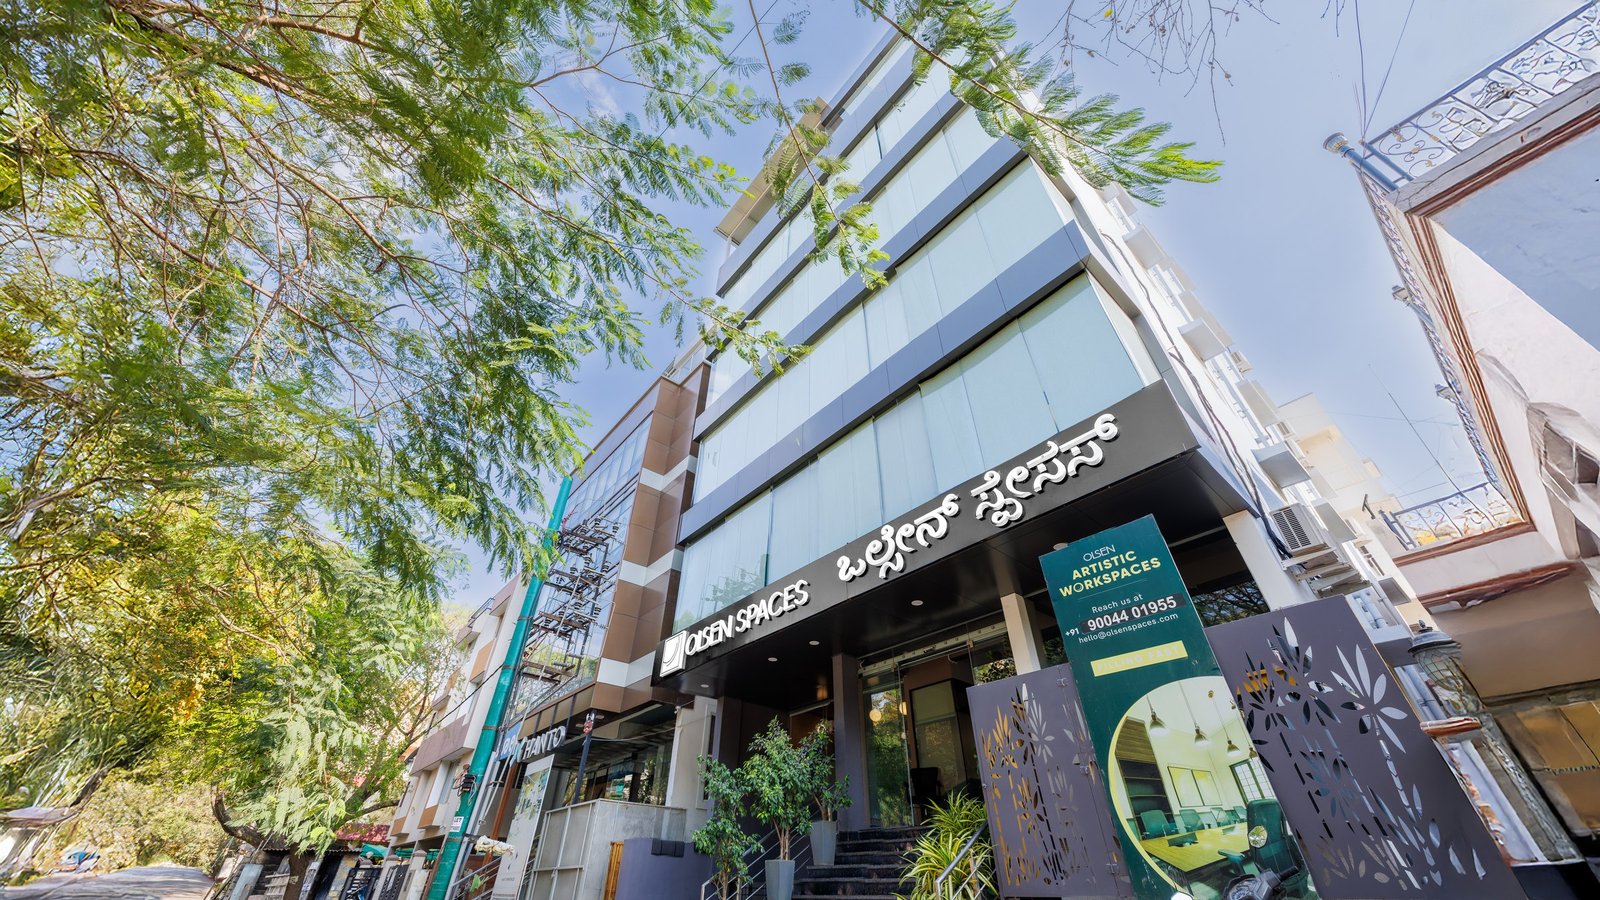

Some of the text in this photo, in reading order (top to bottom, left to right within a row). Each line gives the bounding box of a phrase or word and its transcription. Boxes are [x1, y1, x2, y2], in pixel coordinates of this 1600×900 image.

[1072, 550, 1137, 580] ARTISTIC
[1083, 544, 1116, 562] OLSEN
[1059, 557, 1161, 597] WORKSPACES
[685, 579, 811, 656] OLSEN SPACES
[1065, 595, 1177, 637] +91 90044 01955
[1091, 592, 1143, 614] Reach us at
[1078, 612, 1179, 644] hello@olsenspaces.com
